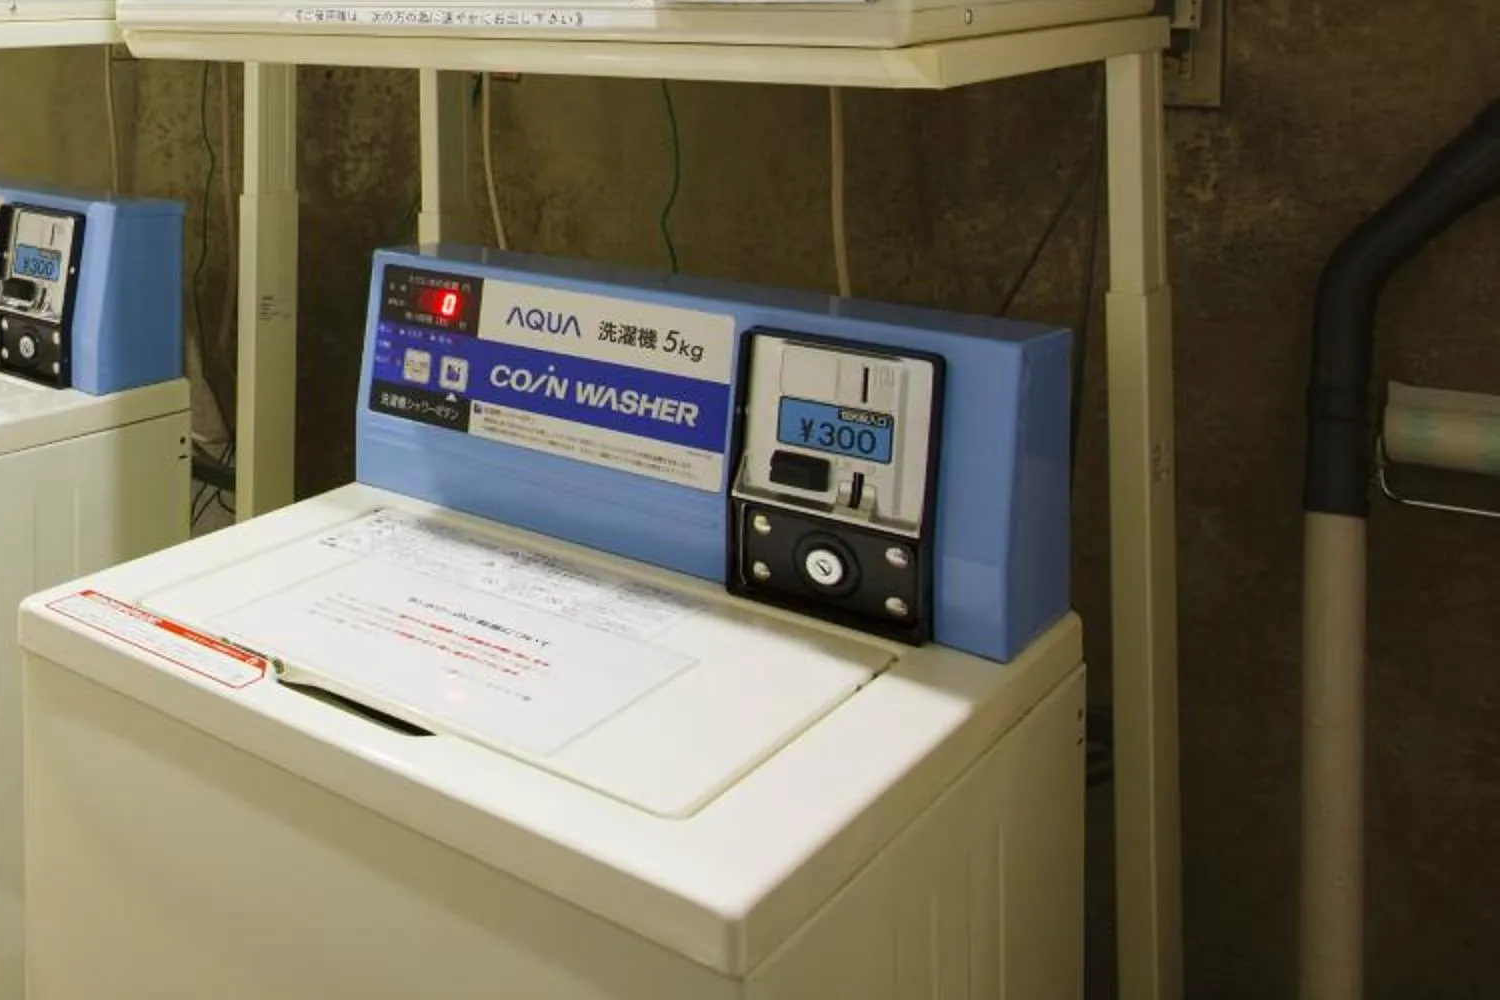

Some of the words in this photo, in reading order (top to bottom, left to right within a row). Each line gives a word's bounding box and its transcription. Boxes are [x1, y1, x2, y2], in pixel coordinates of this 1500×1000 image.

[441, 293, 457, 315] 0
[506, 306, 581, 338] AQUA
[596, 320, 658, 351] 洗濯機
[662, 330, 705, 362] 5kg
[576, 385, 699, 428] WASHER
[800, 416, 877, 455] ¥300
